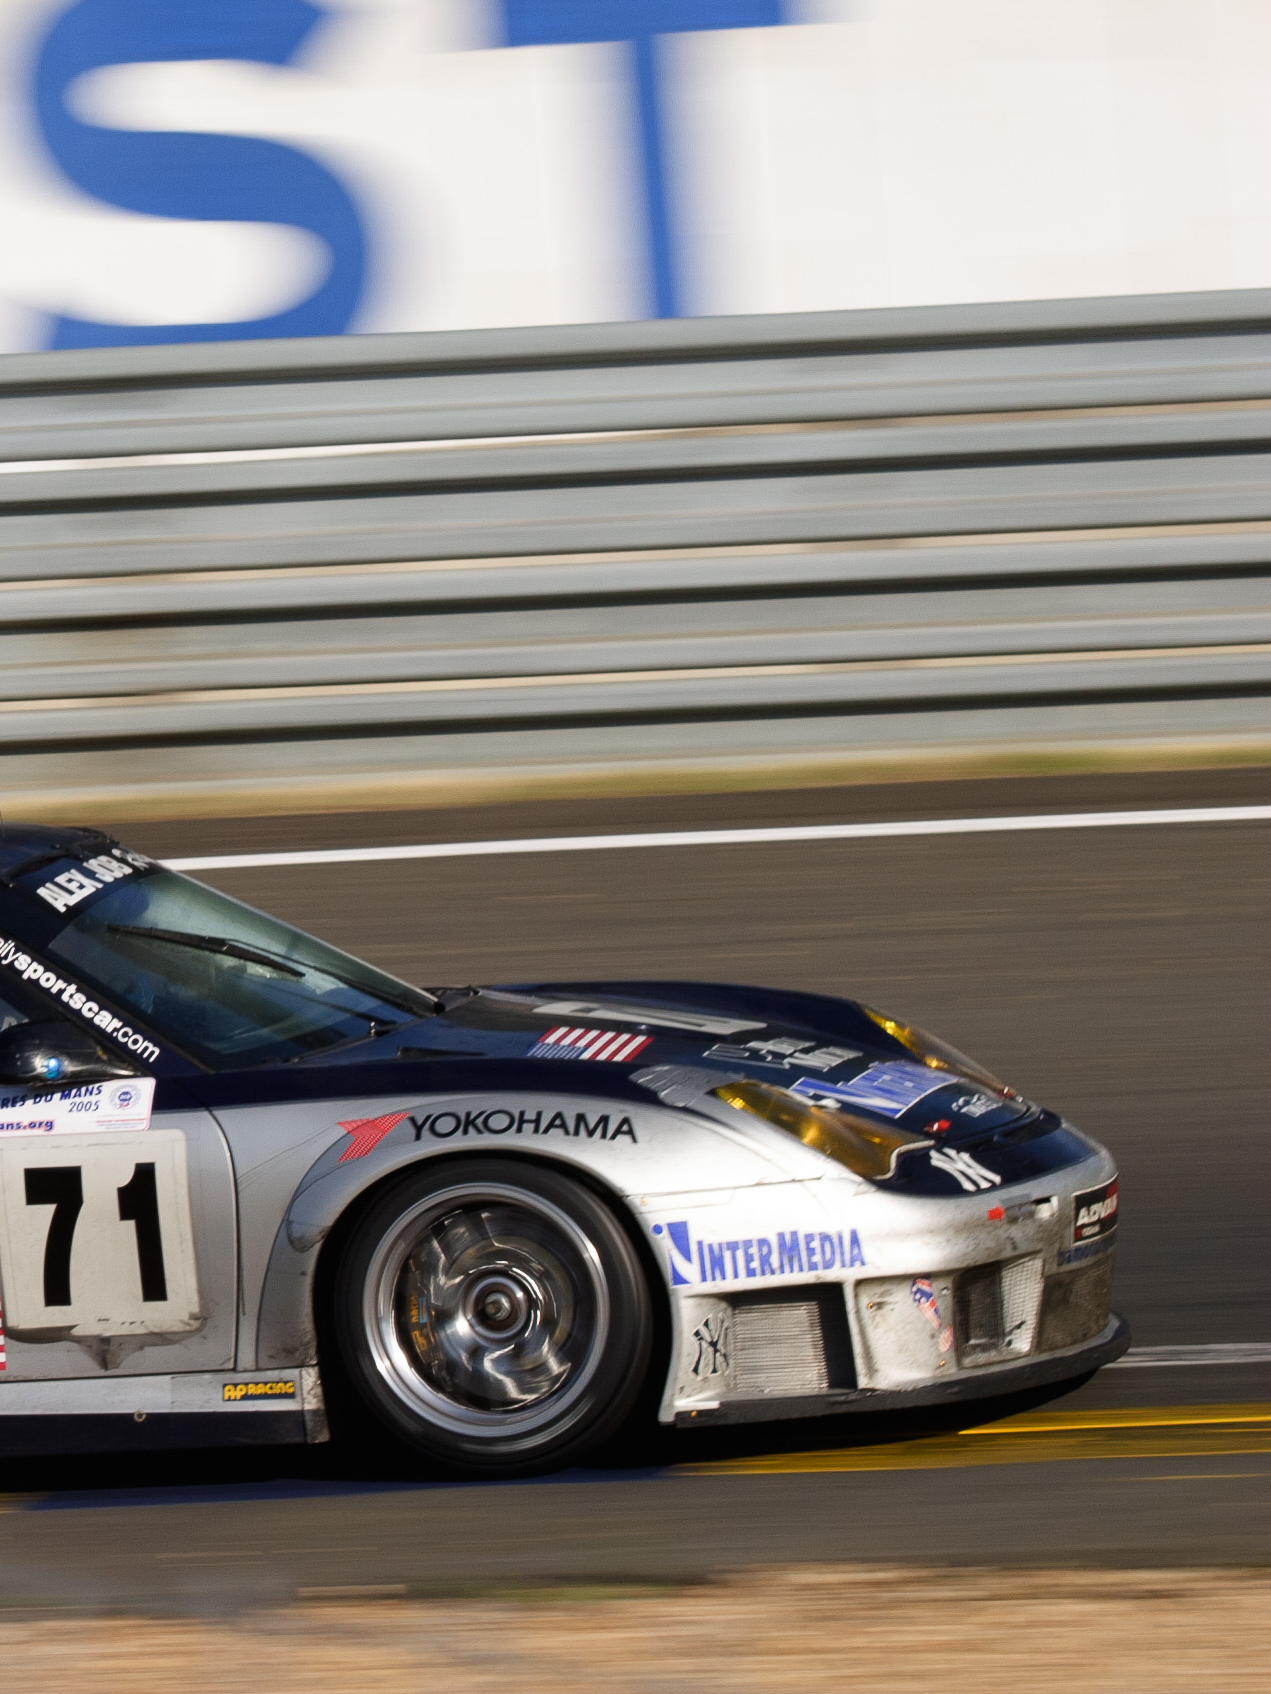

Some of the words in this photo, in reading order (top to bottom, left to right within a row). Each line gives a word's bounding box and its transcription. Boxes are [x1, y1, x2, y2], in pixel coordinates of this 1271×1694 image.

[36, 868, 104, 913] ALEX
[83, 855, 133, 883] JOB
[33, 1091, 55, 1106] DU
[59, 1084, 103, 1102] MANS
[68, 1100, 100, 1113] 2005
[411, 1109, 638, 1143] YOKOHAMA
[24, 1162, 168, 1308] 71
[224, 1384, 247, 1400] AP
[247, 1382, 295, 1395] RACING
